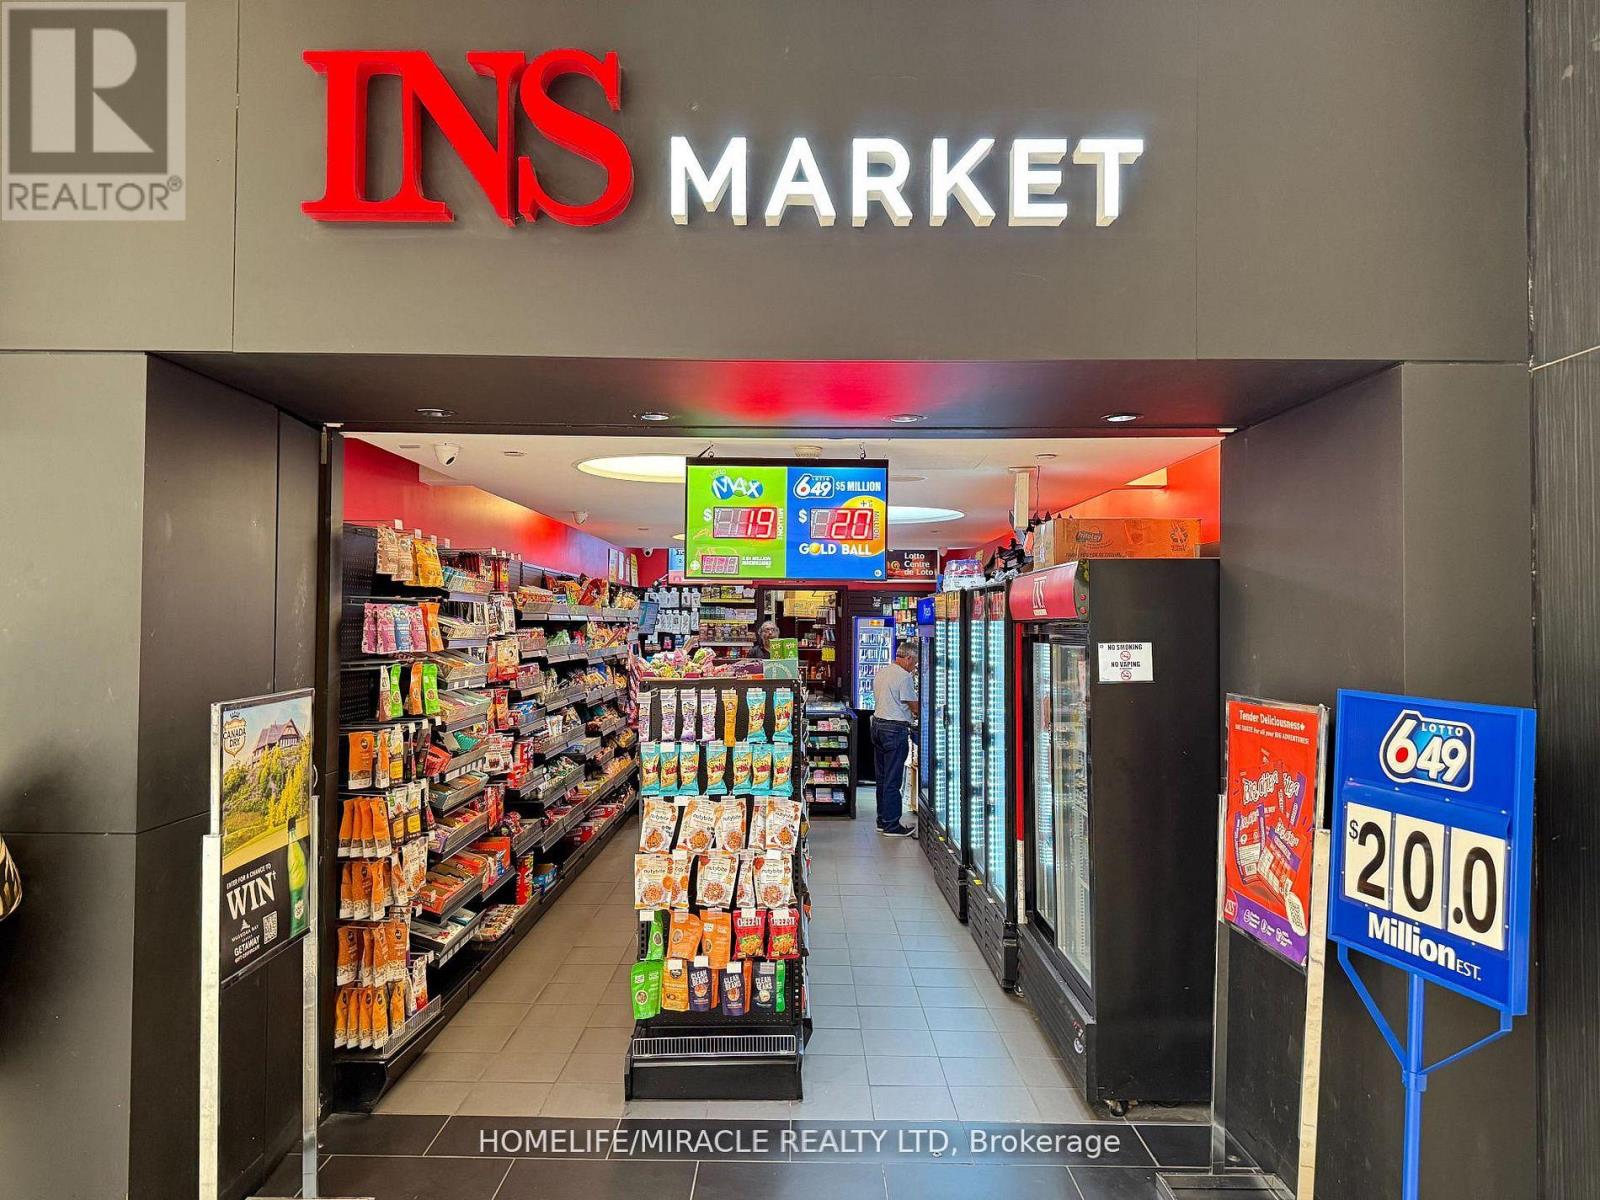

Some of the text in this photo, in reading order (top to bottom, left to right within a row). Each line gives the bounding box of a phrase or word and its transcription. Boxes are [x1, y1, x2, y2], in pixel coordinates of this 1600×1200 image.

[302, 48, 1144, 227] INS MARKET
[712, 475, 762, 499] MAX
[847, 481, 881, 492] MILLION
[841, 543, 872, 556] BALL
[904, 552, 925, 560] Lotto
[904, 560, 930, 568] Centre
[1117, 643, 1143, 651] SMOKING
[1239, 709, 1301, 731] Tender Deliciousness
[223, 727, 247, 740] CANADA
[1421, 722, 1464, 736] LOTTO
[230, 736, 241, 748] DRY
[234, 934, 260, 957] GETAWAY
[1368, 911, 1482, 981] Million EST.
[690, 969, 707, 980] CLEAN
[723, 974, 740, 984] CLEAN
[756, 976, 771, 985] CLEAN
